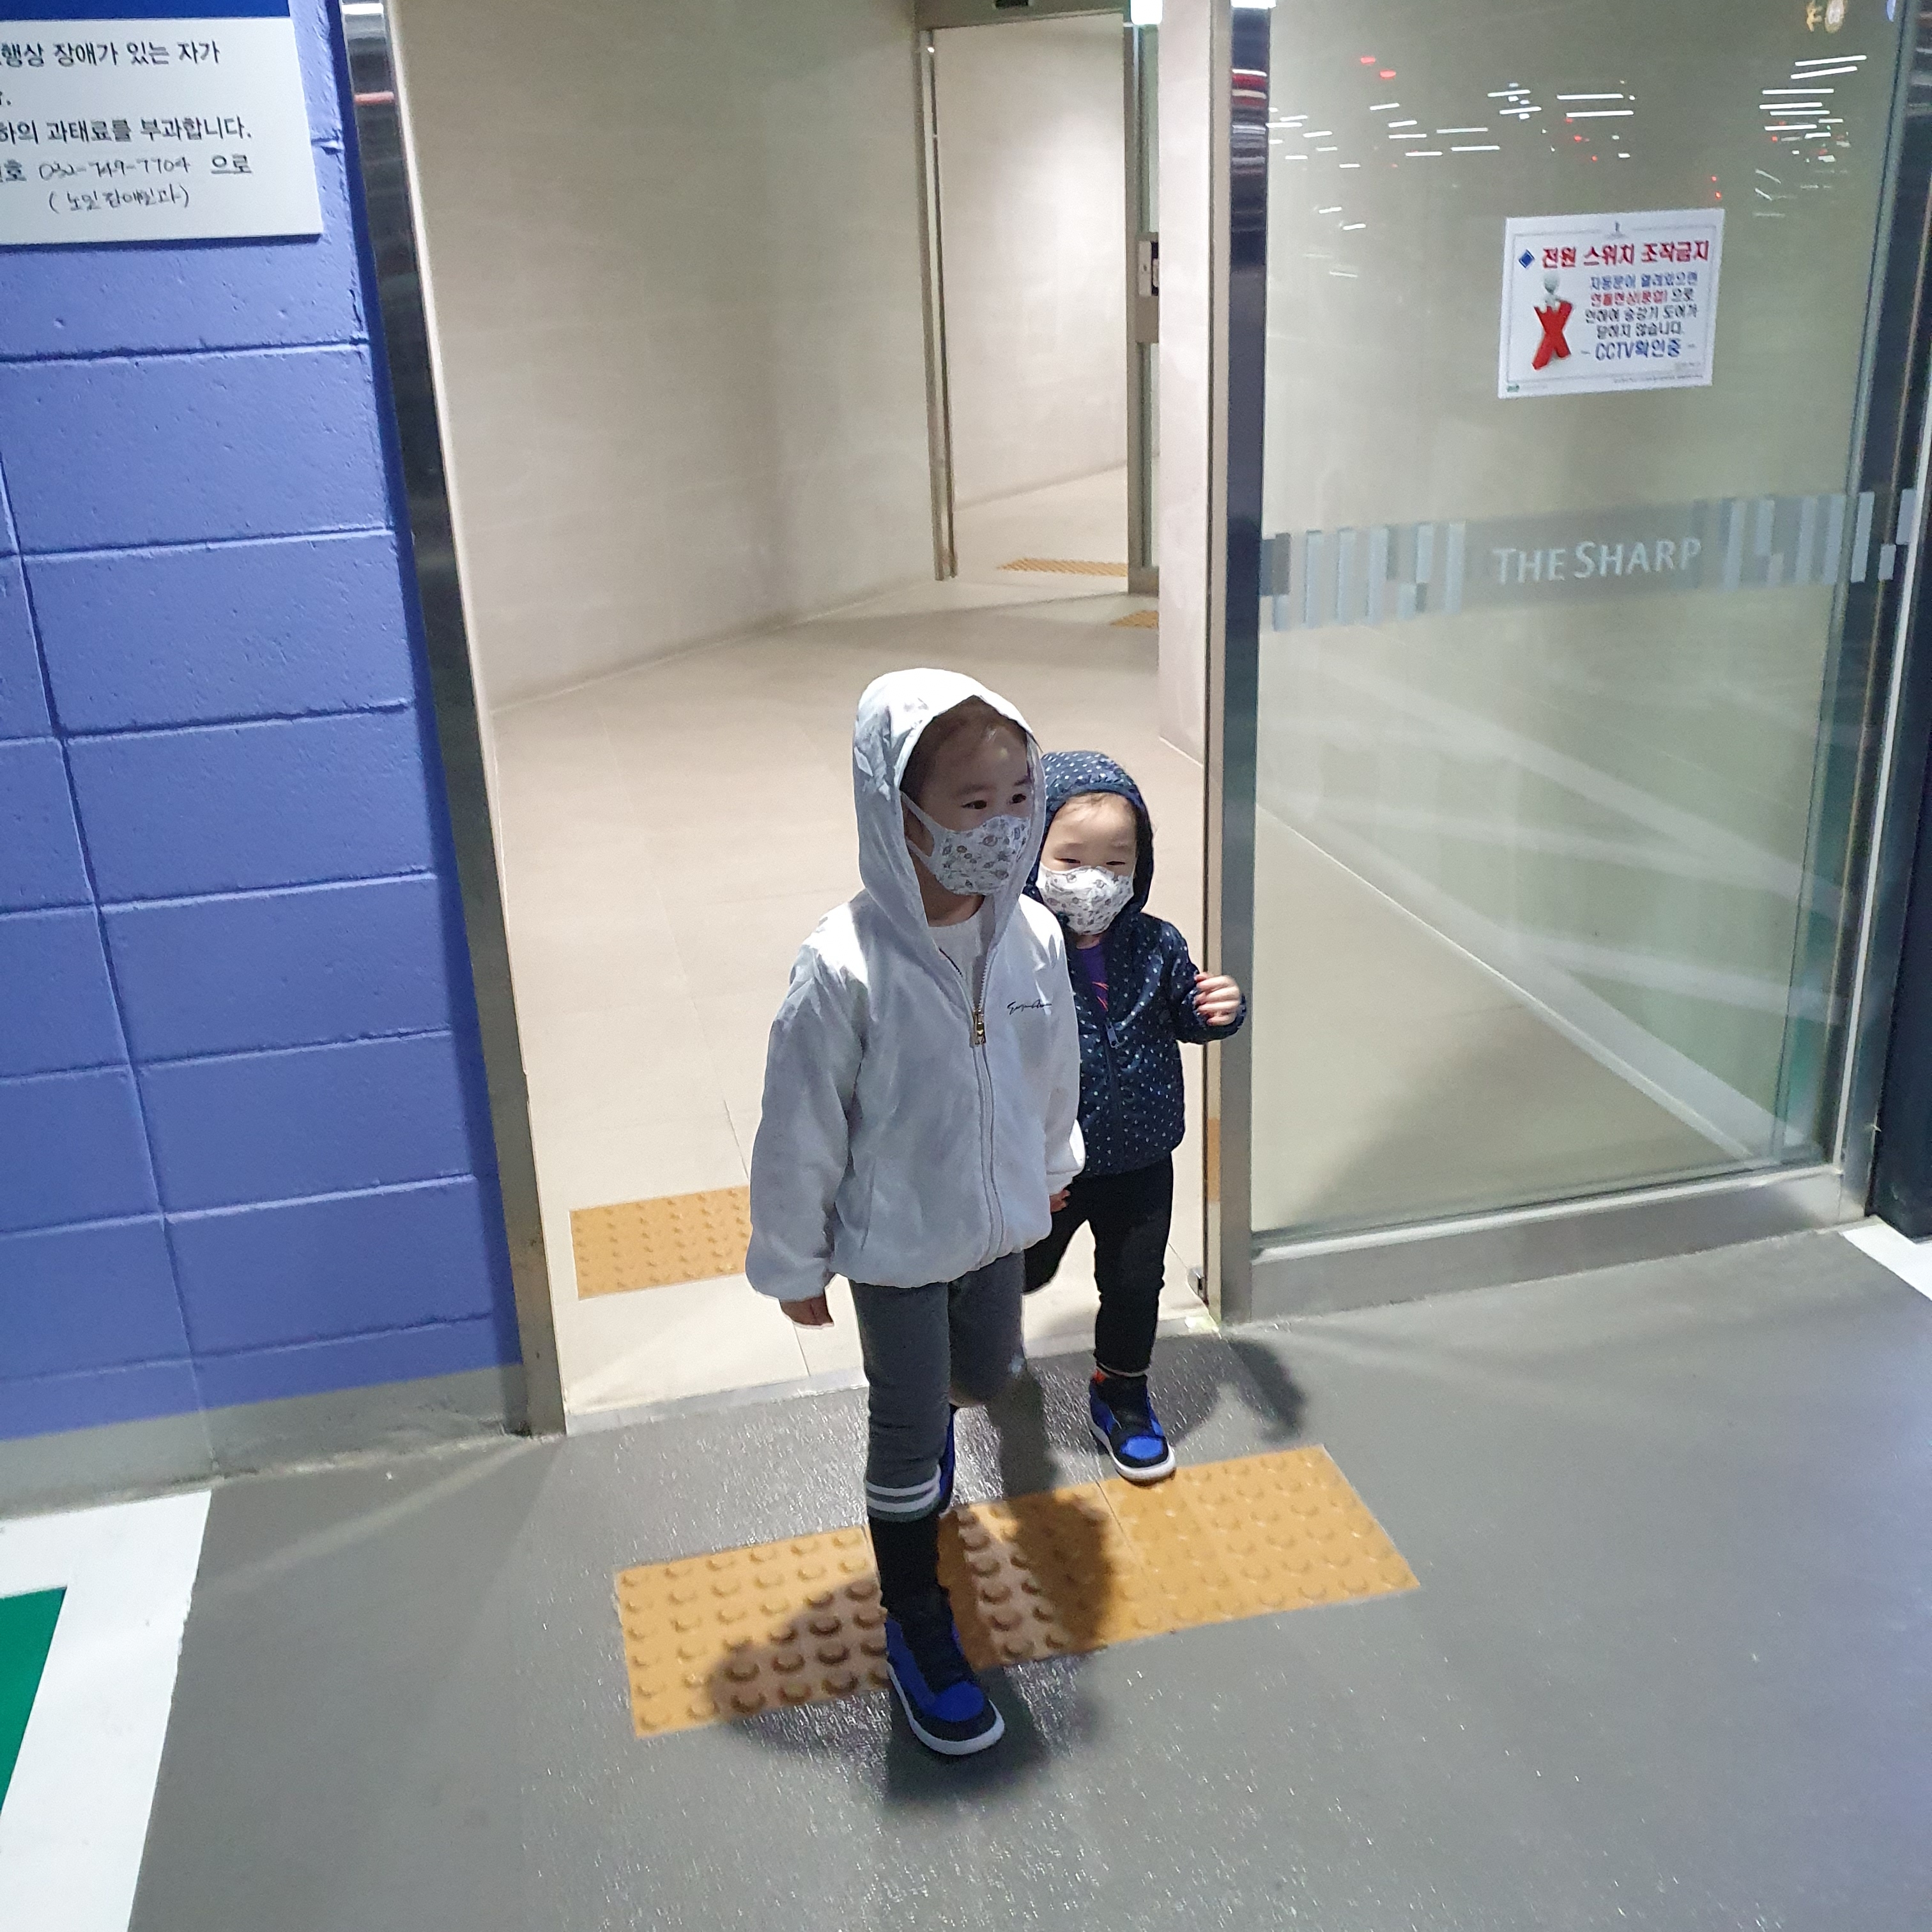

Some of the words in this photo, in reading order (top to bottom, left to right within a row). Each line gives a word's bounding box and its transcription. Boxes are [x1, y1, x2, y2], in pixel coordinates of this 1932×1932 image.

[0, 42, 44, 67] 행상
[54, 42, 119, 67] 장애가
[127, 42, 169, 65] 있는
[177, 40, 220, 64] 자가
[47, 119, 132, 143] 과태료를
[141, 116, 252, 141] 부과합니다.
[0, 159, 27, 181] 호
[211, 154, 252, 174] 으로
[1542, 246, 1576, 269] 전원
[1583, 244, 1634, 266] 스위치
[1641, 240, 1709, 263] 조작금지
[1595, 338, 1682, 361] CCTV확인중
[1492, 548, 1565, 584] THE
[1574, 537, 1701, 579] SHARP
